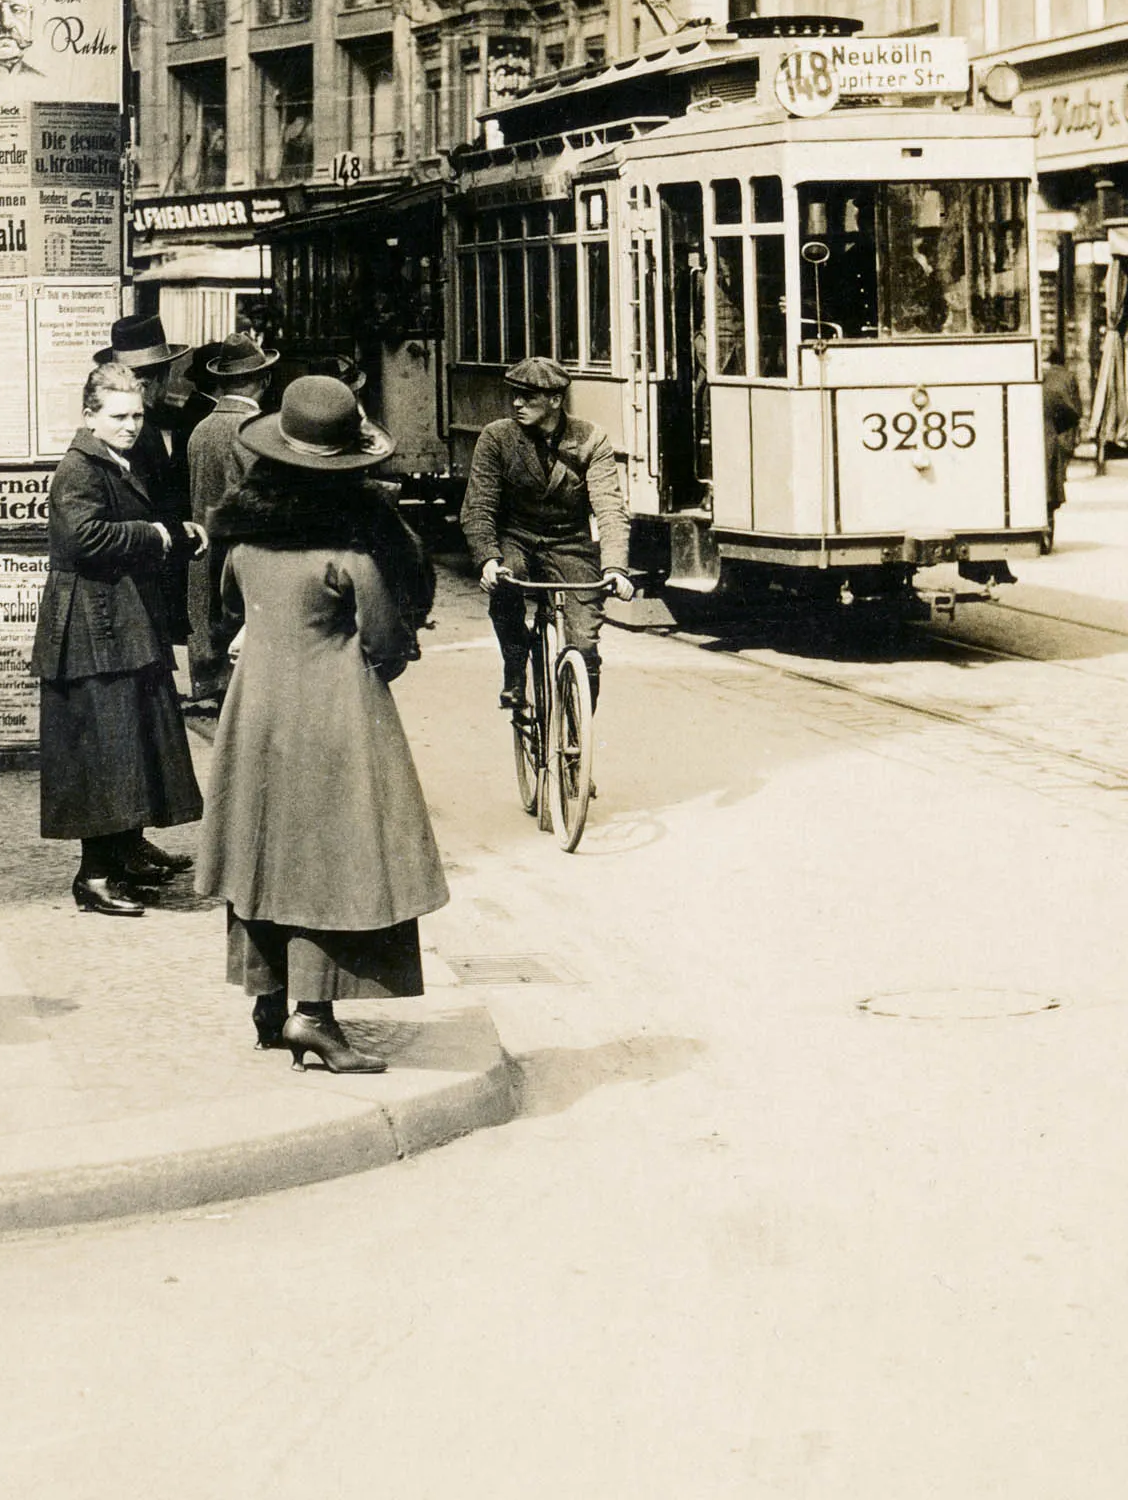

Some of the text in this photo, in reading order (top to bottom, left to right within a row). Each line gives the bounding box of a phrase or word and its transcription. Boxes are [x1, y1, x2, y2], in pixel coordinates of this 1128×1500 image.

[831, 43, 933, 69] Neukölln
[333, 154, 361, 182] 148
[860, 410, 977, 452] 3285
